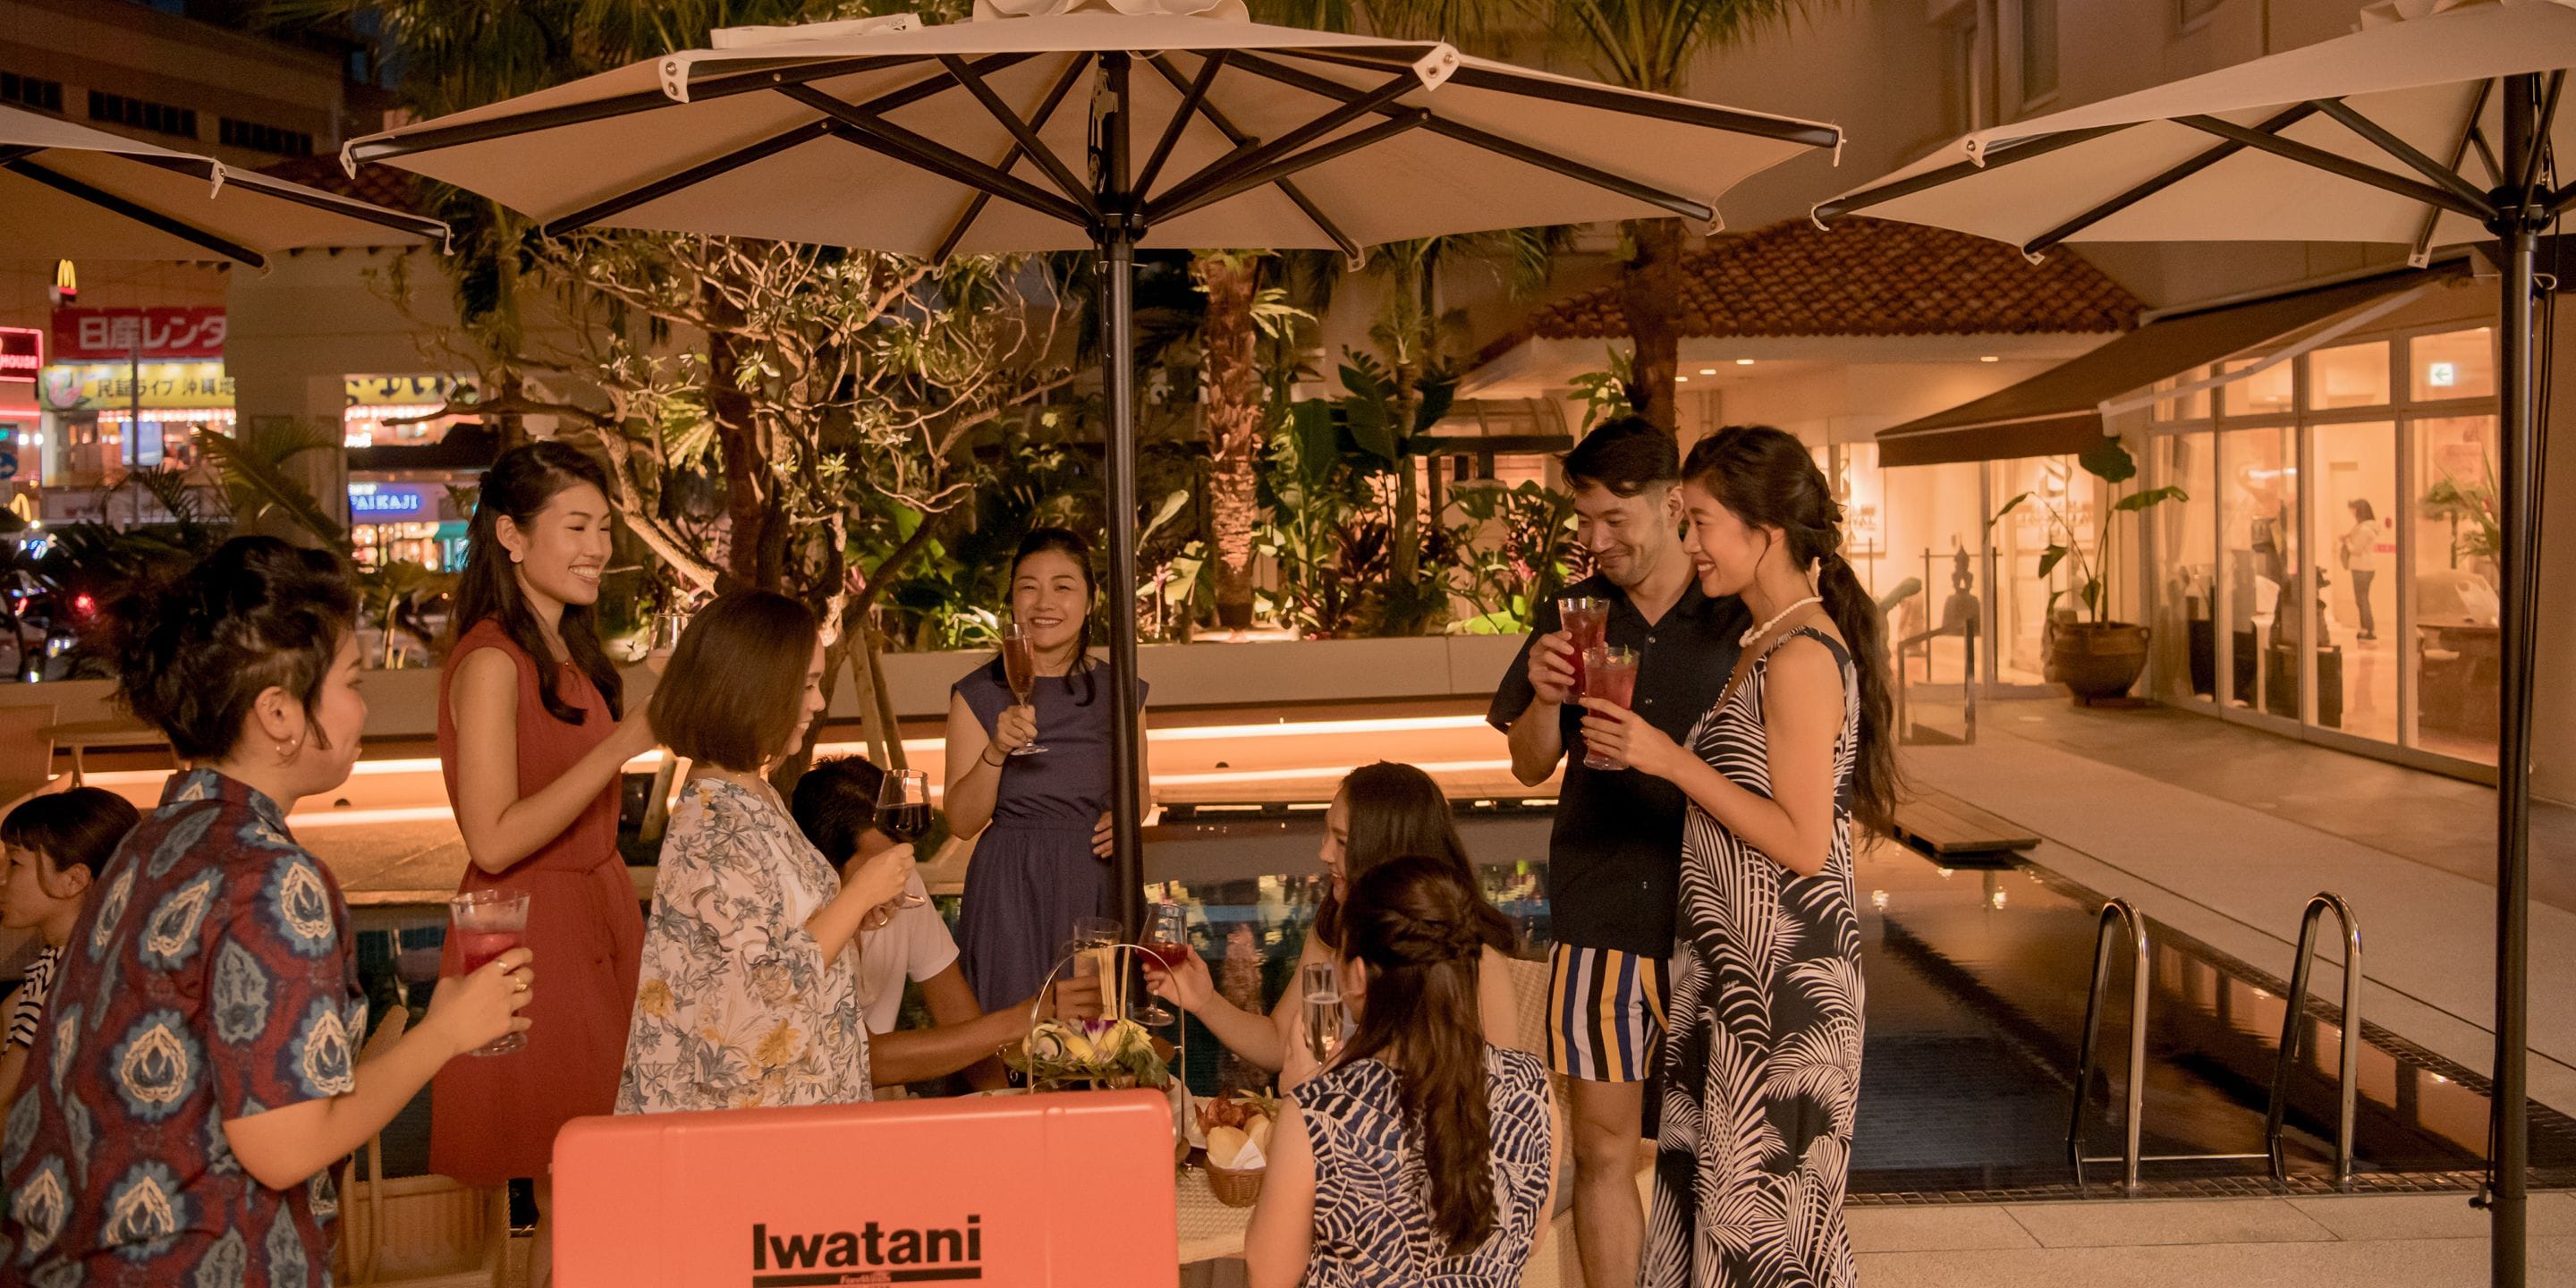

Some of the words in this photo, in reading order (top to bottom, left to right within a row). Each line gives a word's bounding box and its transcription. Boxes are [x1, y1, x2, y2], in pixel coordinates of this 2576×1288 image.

[79, 316, 226, 351] 日産レンタ
[753, 1215, 981, 1270] Iwatani
